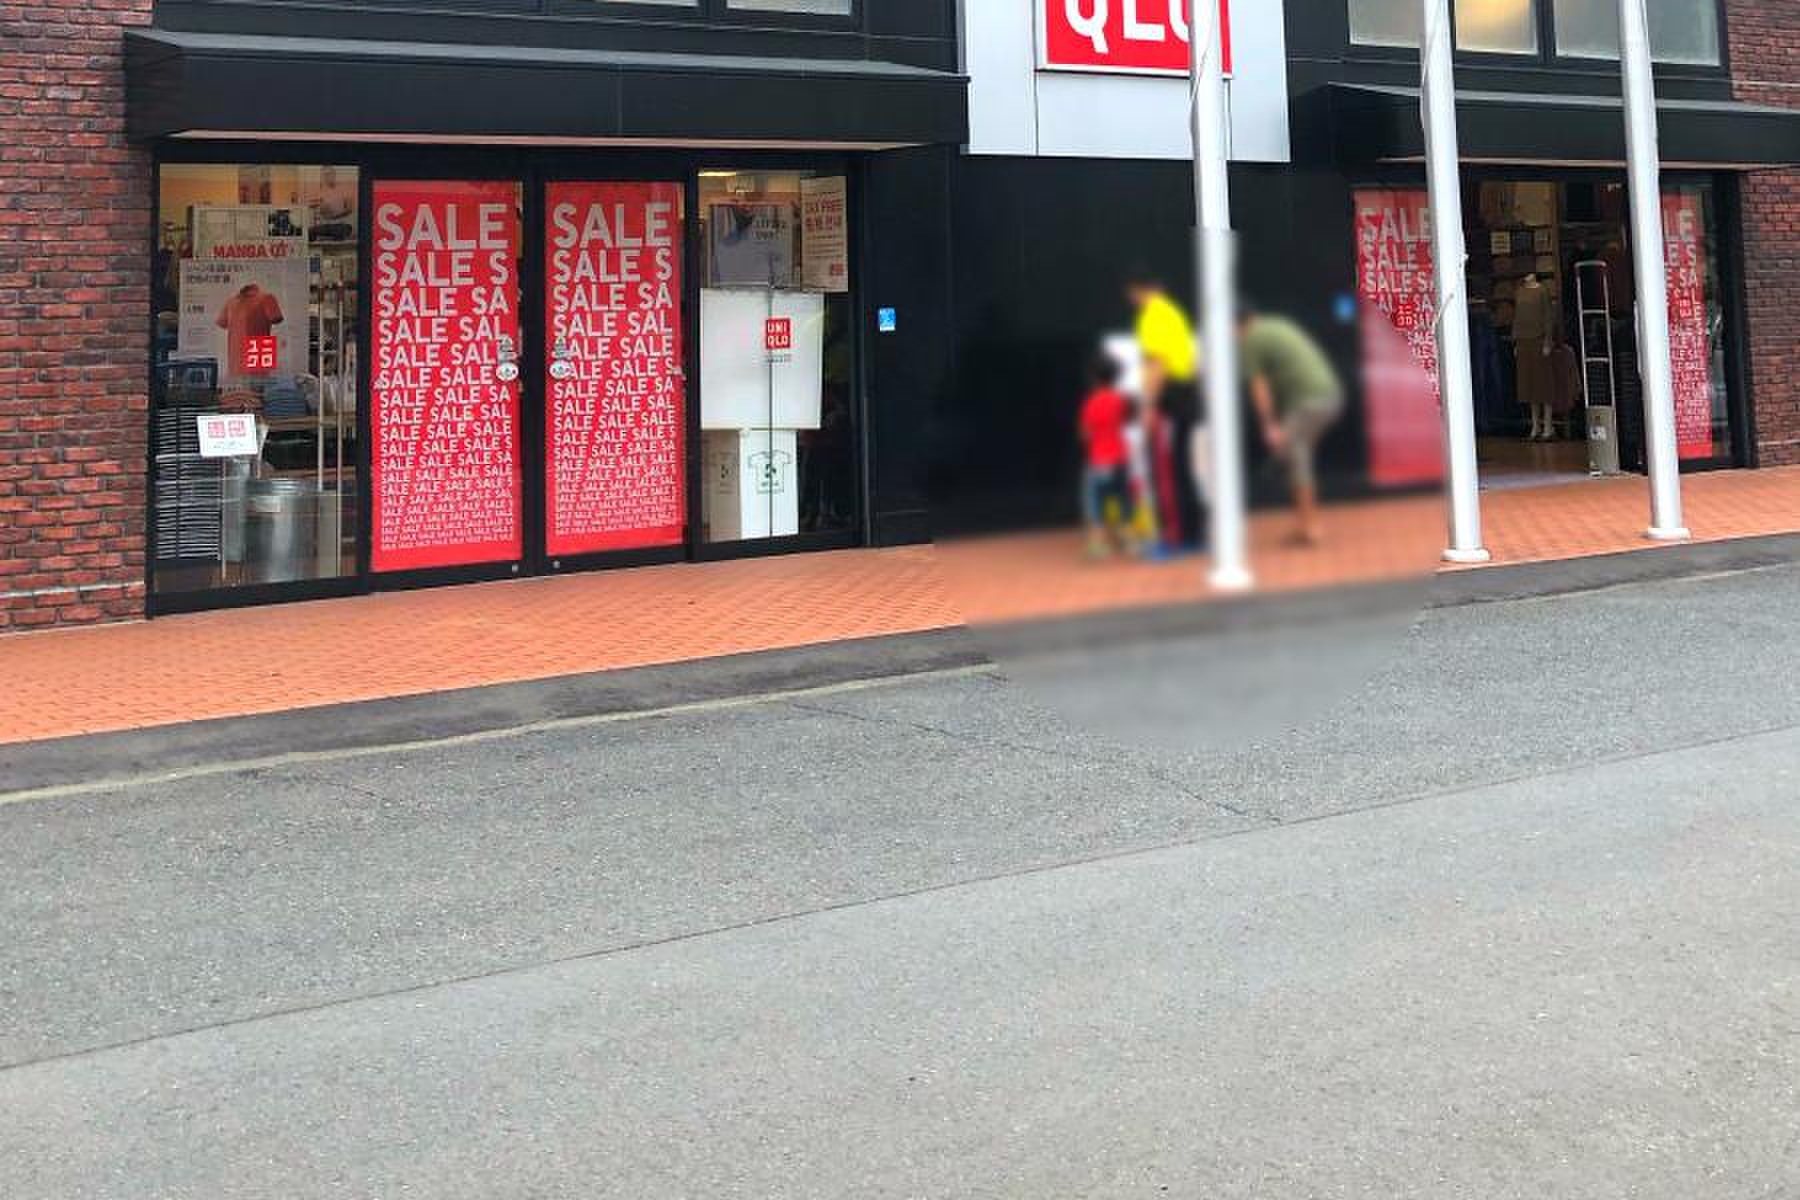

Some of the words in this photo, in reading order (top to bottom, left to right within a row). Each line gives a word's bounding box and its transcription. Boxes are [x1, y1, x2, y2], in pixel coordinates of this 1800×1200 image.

[377, 203, 509, 250] SALE
[553, 202, 672, 249] SALE
[377, 251, 474, 287] SALE
[489, 251, 509, 285] S
[553, 249, 641, 283] SALE
[656, 248, 672, 280] S
[377, 287, 458, 317] SALE
[472, 286, 509, 315] SA
[553, 283, 626, 312] SALE
[638, 282, 672, 309] SA
[379, 317, 448, 345] SALE
[459, 316, 508, 342] SAL
[553, 312, 618, 337] SALE
[627, 310, 672, 336] SAL
[767, 321, 788, 333] UNI
[379, 344, 441, 368] SALE
[451, 343, 502, 365] SAL
[558, 338, 611, 360] ALE
[620, 336, 672, 358] SALE
[381, 368, 432, 389] SALE
[440, 366, 493, 387] SALE
[561, 360, 603, 379] ALE
[611, 359, 658, 378] SALE
[380, 389, 427, 408] SALE
[434, 388, 480, 406] SALE
[489, 386, 511, 402] SA
[553, 381, 599, 399] SALE
[605, 378, 648, 397] SALE
[655, 377, 673, 393] SA
[380, 408, 423, 426] SALE
[430, 406, 473, 422] SALE
[480, 404, 511, 419] SAL
[553, 399, 595, 416] SALE
[602, 397, 641, 413] SALE
[648, 395, 674, 409] SAL
[380, 426, 419, 442] SALE
[427, 424, 466, 439] SALE
[473, 422, 512, 436] SALE
[554, 416, 593, 431] SALE
[598, 413, 635, 429] SALE
[641, 411, 674, 426] SALE
[381, 443, 416, 457] SALE
[422, 439, 459, 455] SALE
[464, 437, 500, 450] SALE
[505, 436, 512, 449] S
[554, 431, 588, 446] SALE
[594, 429, 627, 443] SALE
[633, 427, 664, 440] SALE
[381, 457, 414, 471] SALE
[419, 455, 452, 469] SALE
[458, 453, 491, 465] SALE
[497, 451, 512, 464] SA
